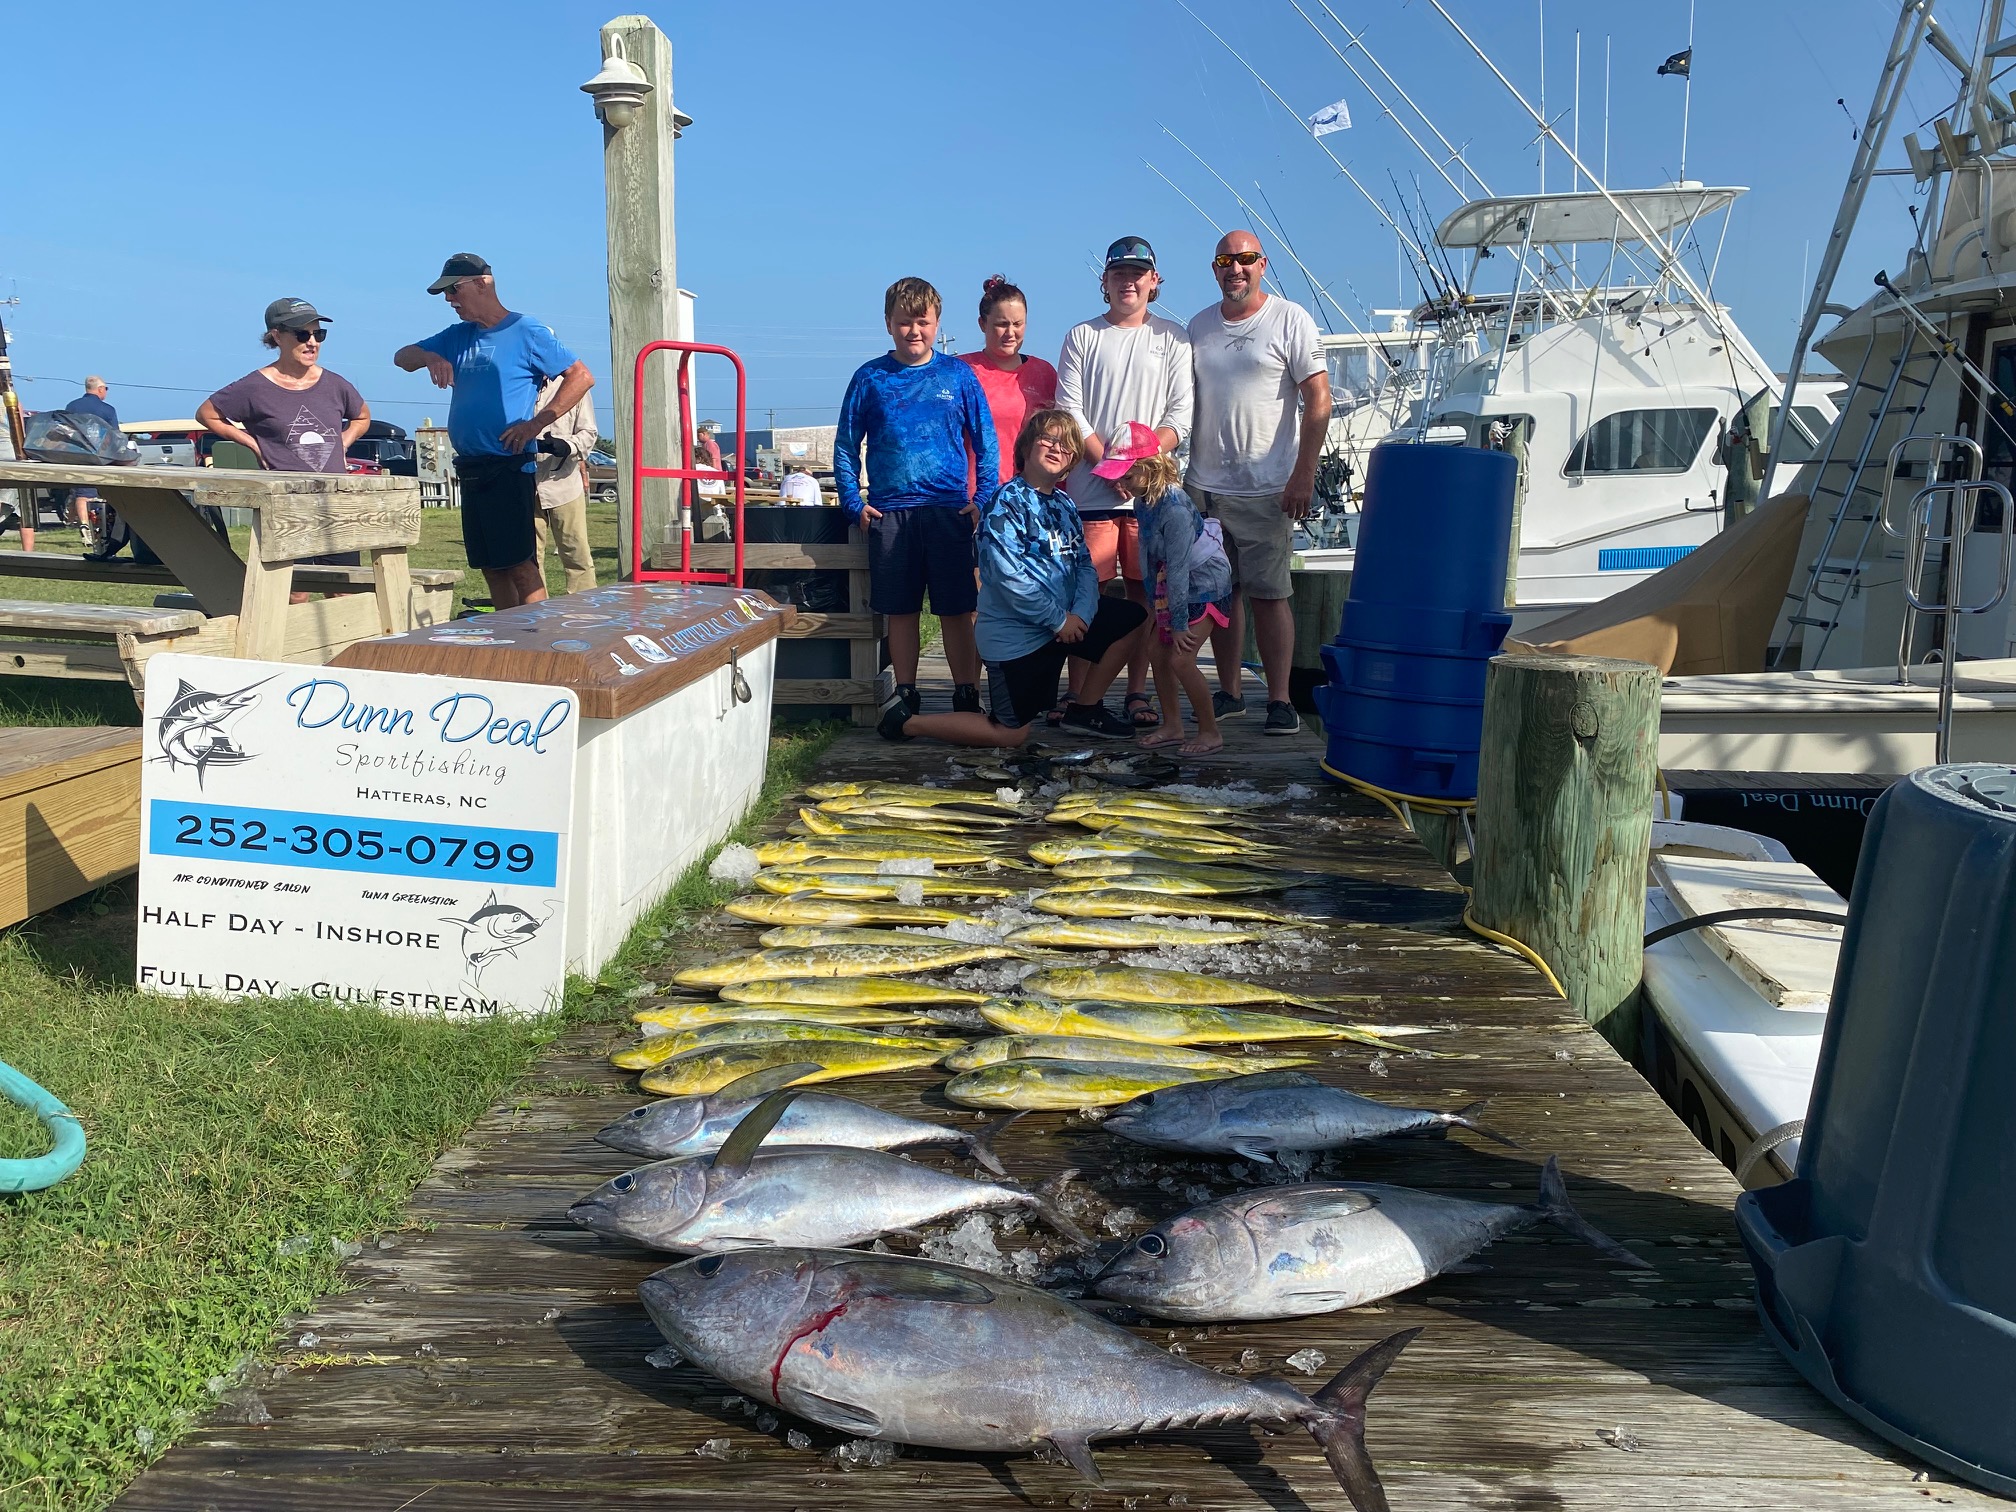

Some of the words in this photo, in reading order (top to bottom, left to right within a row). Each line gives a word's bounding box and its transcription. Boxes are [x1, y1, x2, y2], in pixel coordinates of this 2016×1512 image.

[286, 678, 414, 735] Dunn
[429, 692, 571, 754] Deal
[336, 743, 507, 785] Sportfishing
[356, 787, 452, 808] HATTERAS,
[459, 795, 488, 809] NC
[1740, 792, 1800, 812] Deal
[174, 814, 535, 873] 252-305-0799
[172, 873, 194, 882] AIR
[196, 875, 269, 890] CONDITIONED
[273, 882, 311, 894] SALON
[361, 889, 389, 900] TUNA
[392, 892, 459, 906] GREENSTICK
[142, 905, 216, 928] HALF
[228, 913, 284, 935] DAY
[316, 921, 440, 949] INSHORE
[140, 965, 212, 990] FULL
[225, 973, 280, 996] DAY
[311, 981, 499, 1015] GULFSTREAM
